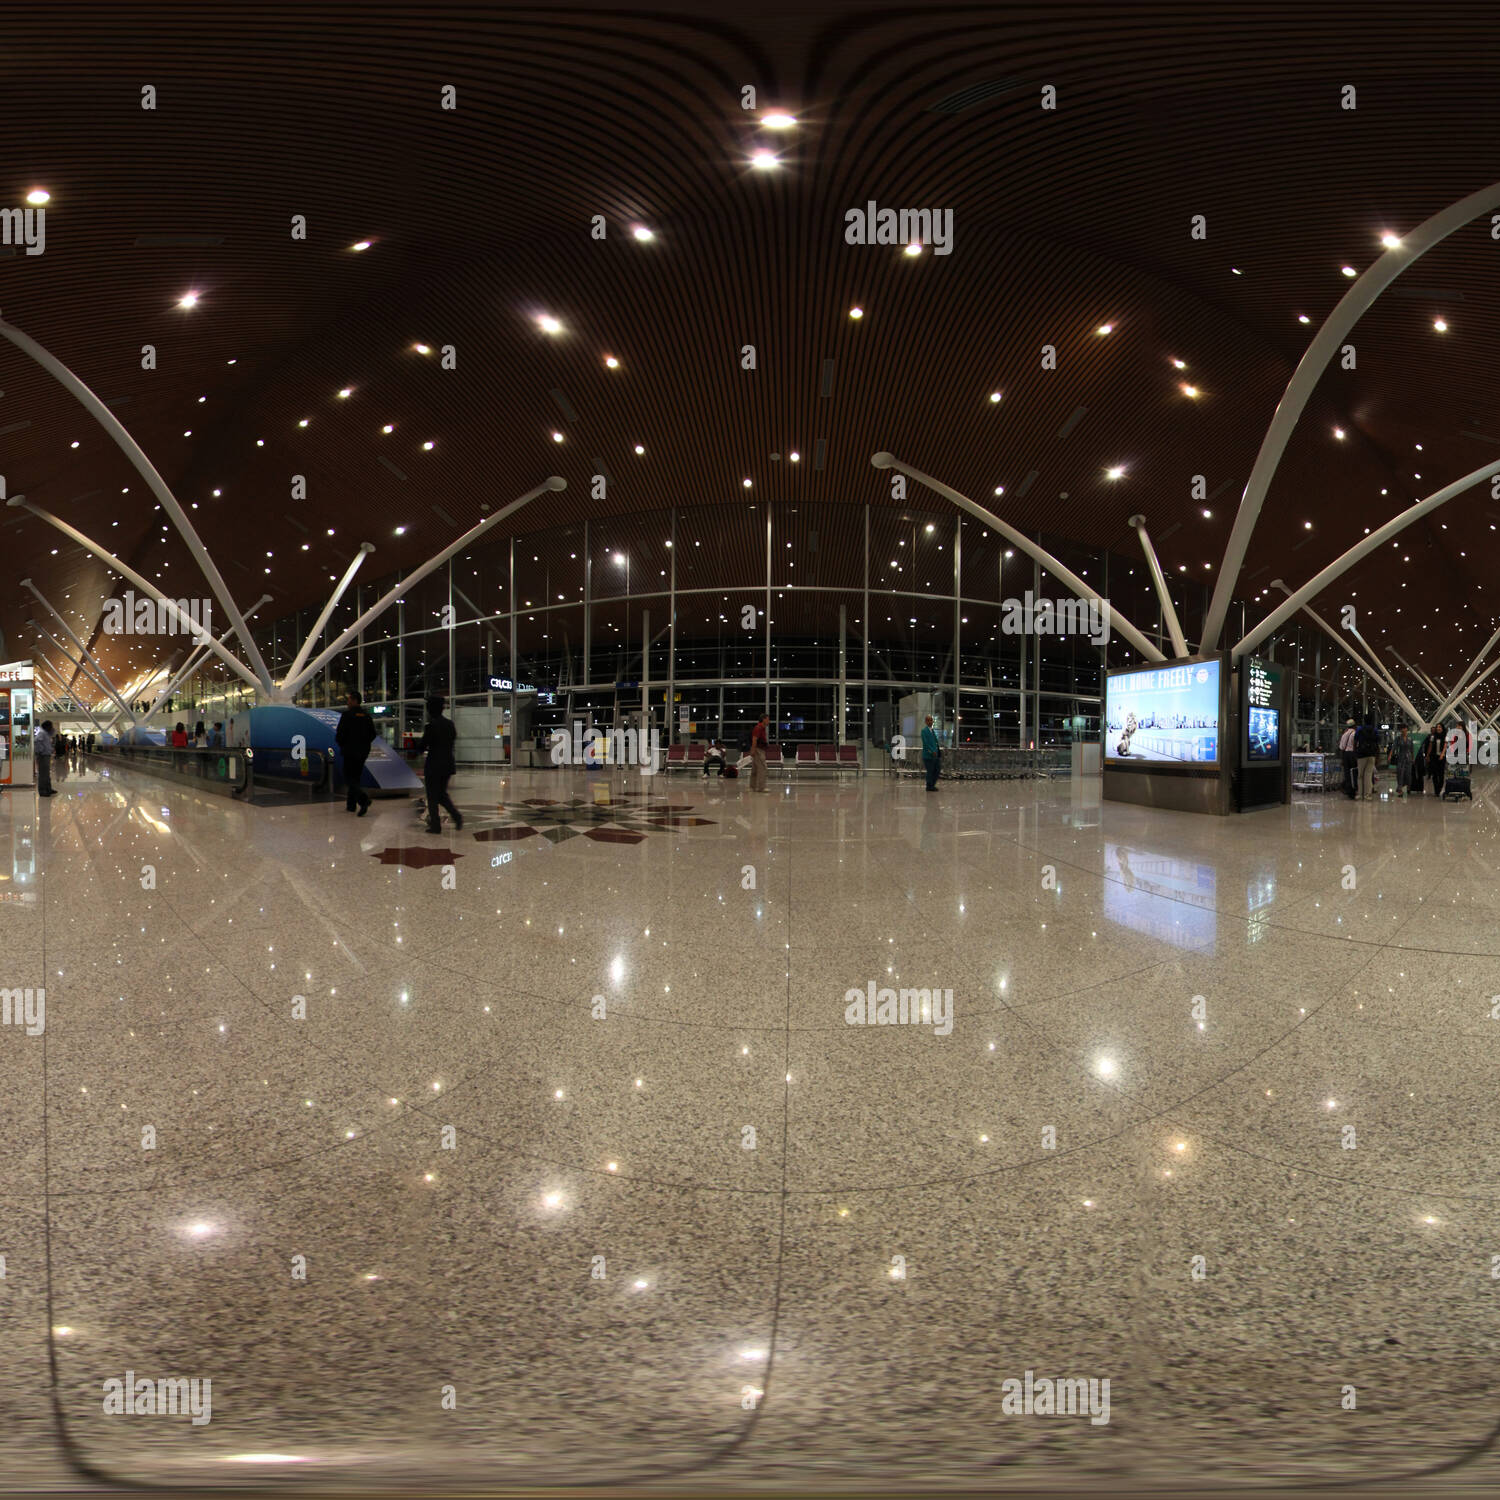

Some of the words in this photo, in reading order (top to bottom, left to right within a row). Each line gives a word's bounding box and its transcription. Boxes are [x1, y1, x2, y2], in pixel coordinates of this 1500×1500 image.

[1108, 677, 1127, 693] CALL
[1129, 671, 1156, 691] HOME
[1158, 667, 1194, 689] FREELY
